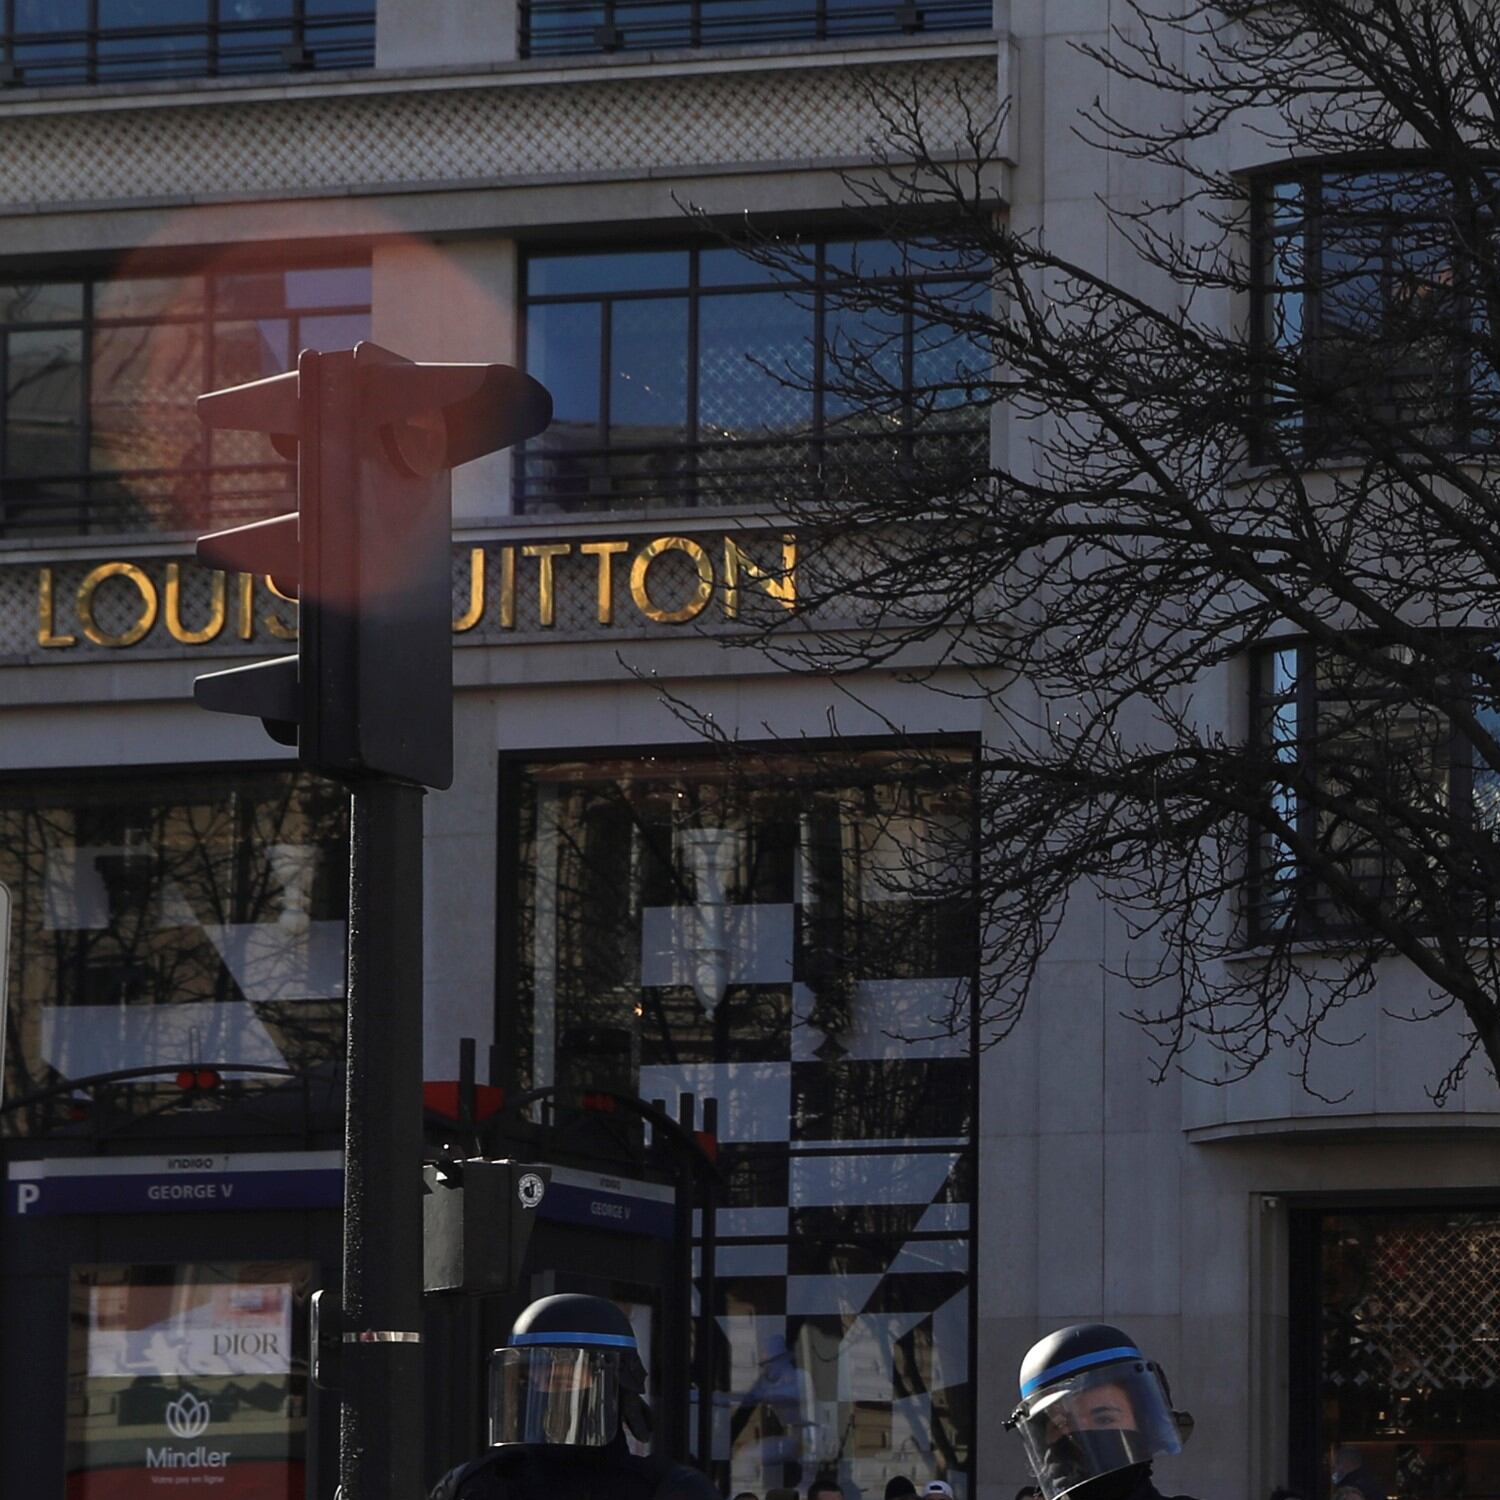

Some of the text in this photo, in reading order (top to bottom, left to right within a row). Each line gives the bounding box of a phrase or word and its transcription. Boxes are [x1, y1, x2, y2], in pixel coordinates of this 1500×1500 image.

[17, 1183, 40, 1214] P
[147, 1183, 234, 1200] GEORGE V
[590, 1201, 623, 1218] GEORGE
[213, 1333, 280, 1356] DIOR
[145, 1446, 231, 1468] Mindler
